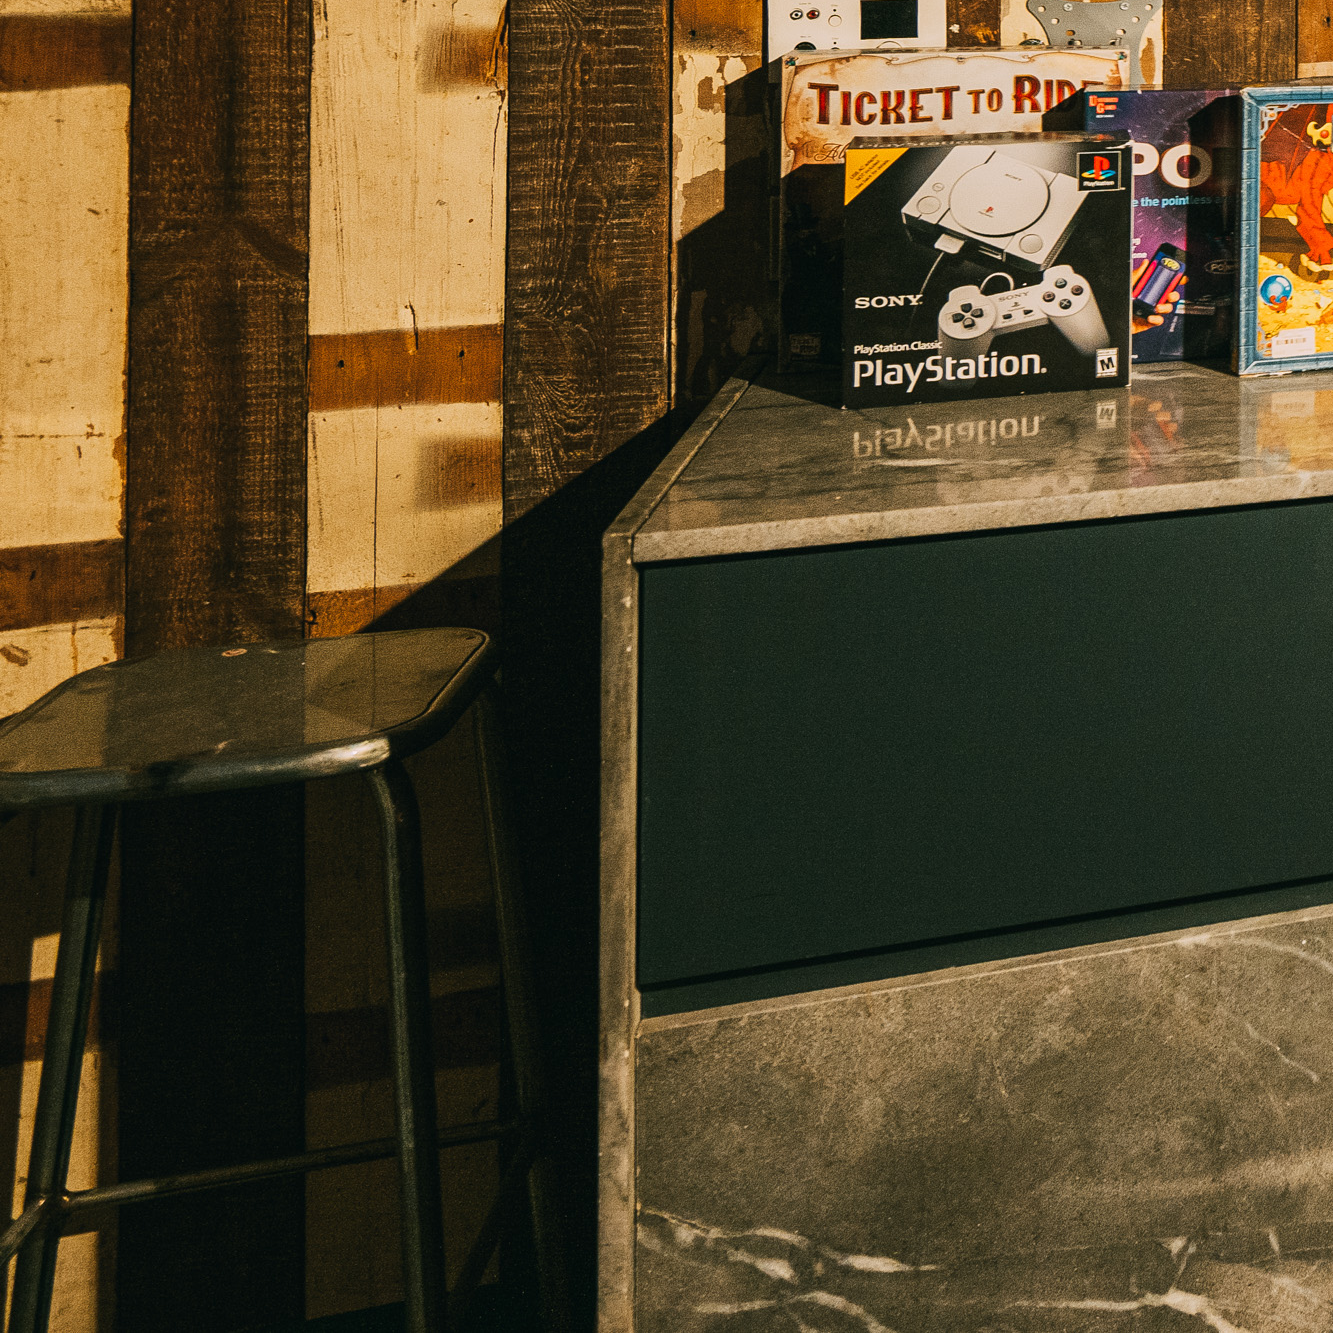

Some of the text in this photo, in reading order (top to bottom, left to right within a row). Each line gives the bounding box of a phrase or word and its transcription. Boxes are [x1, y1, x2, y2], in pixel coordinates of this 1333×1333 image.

[808, 81, 960, 126] TICKET
[966, 87, 1003, 114] TO
[1012, 74, 1104, 114] RID
[1141, 196, 1159, 207] the
[854, 294, 923, 310] SONY
[999, 291, 1029, 302] SONY
[854, 340, 943, 356] PlayStation Classic
[1099, 356, 1115, 371] M
